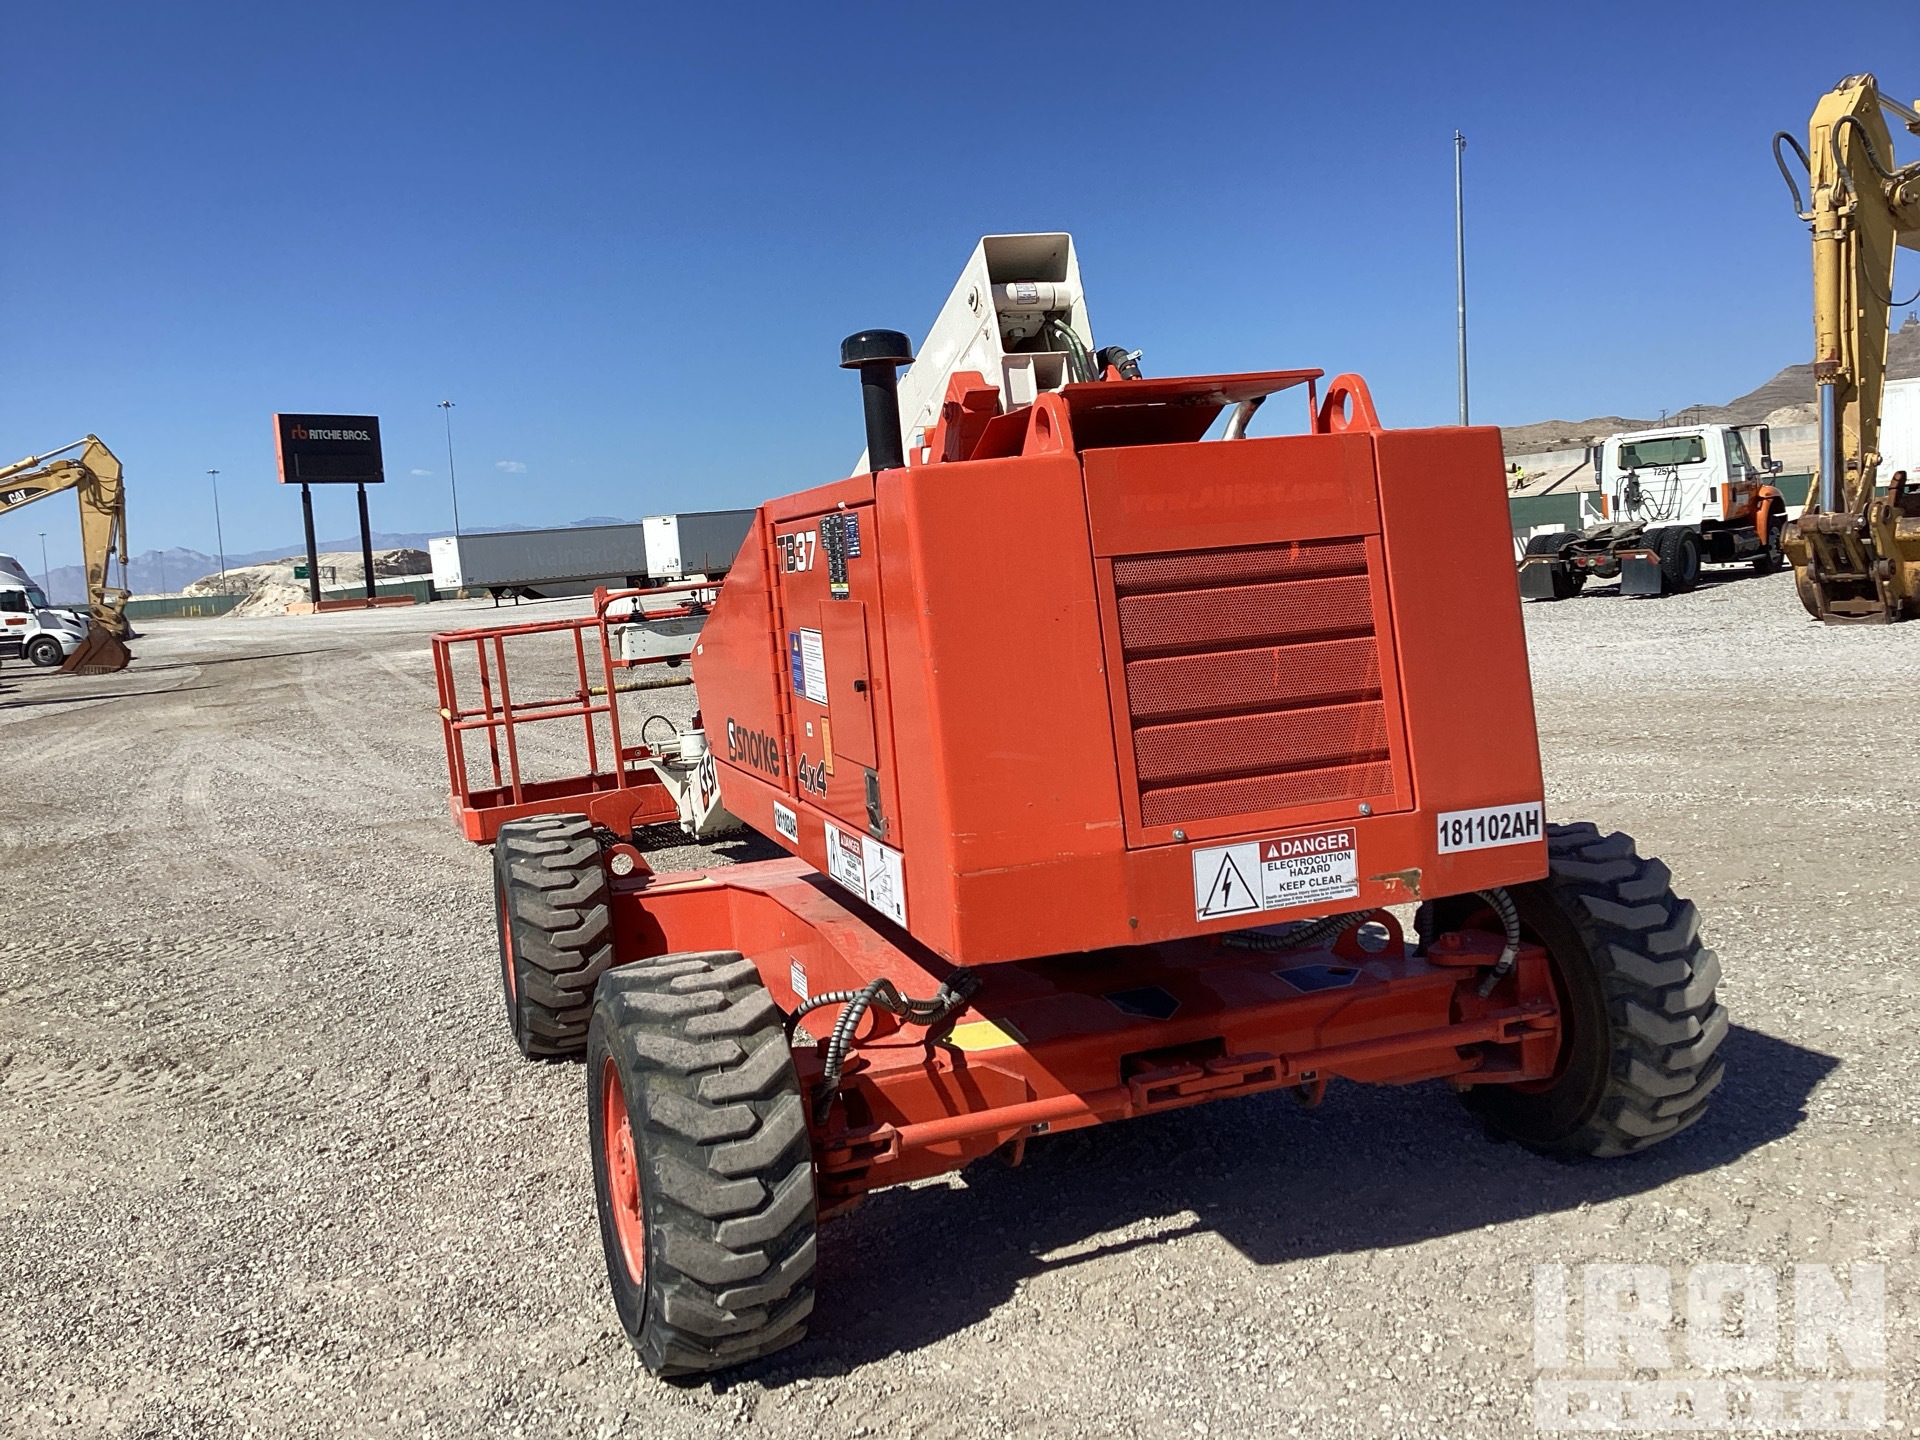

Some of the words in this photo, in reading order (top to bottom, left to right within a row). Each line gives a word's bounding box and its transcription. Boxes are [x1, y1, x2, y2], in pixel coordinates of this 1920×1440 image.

[309, 429, 342, 440] RITCHIE
[343, 430, 371, 441] BROS.
[8, 489, 27, 504] CAT
[777, 530, 817, 574] TB37
[1439, 808, 1540, 847] 181102AH
[1280, 833, 1350, 856] DANGER
[1267, 851, 1351, 872] ELECTROCUTION
[1289, 863, 1331, 878] HAZARD
[1279, 880, 1306, 891] KEEP
[1308, 874, 1342, 888] CLEAR
